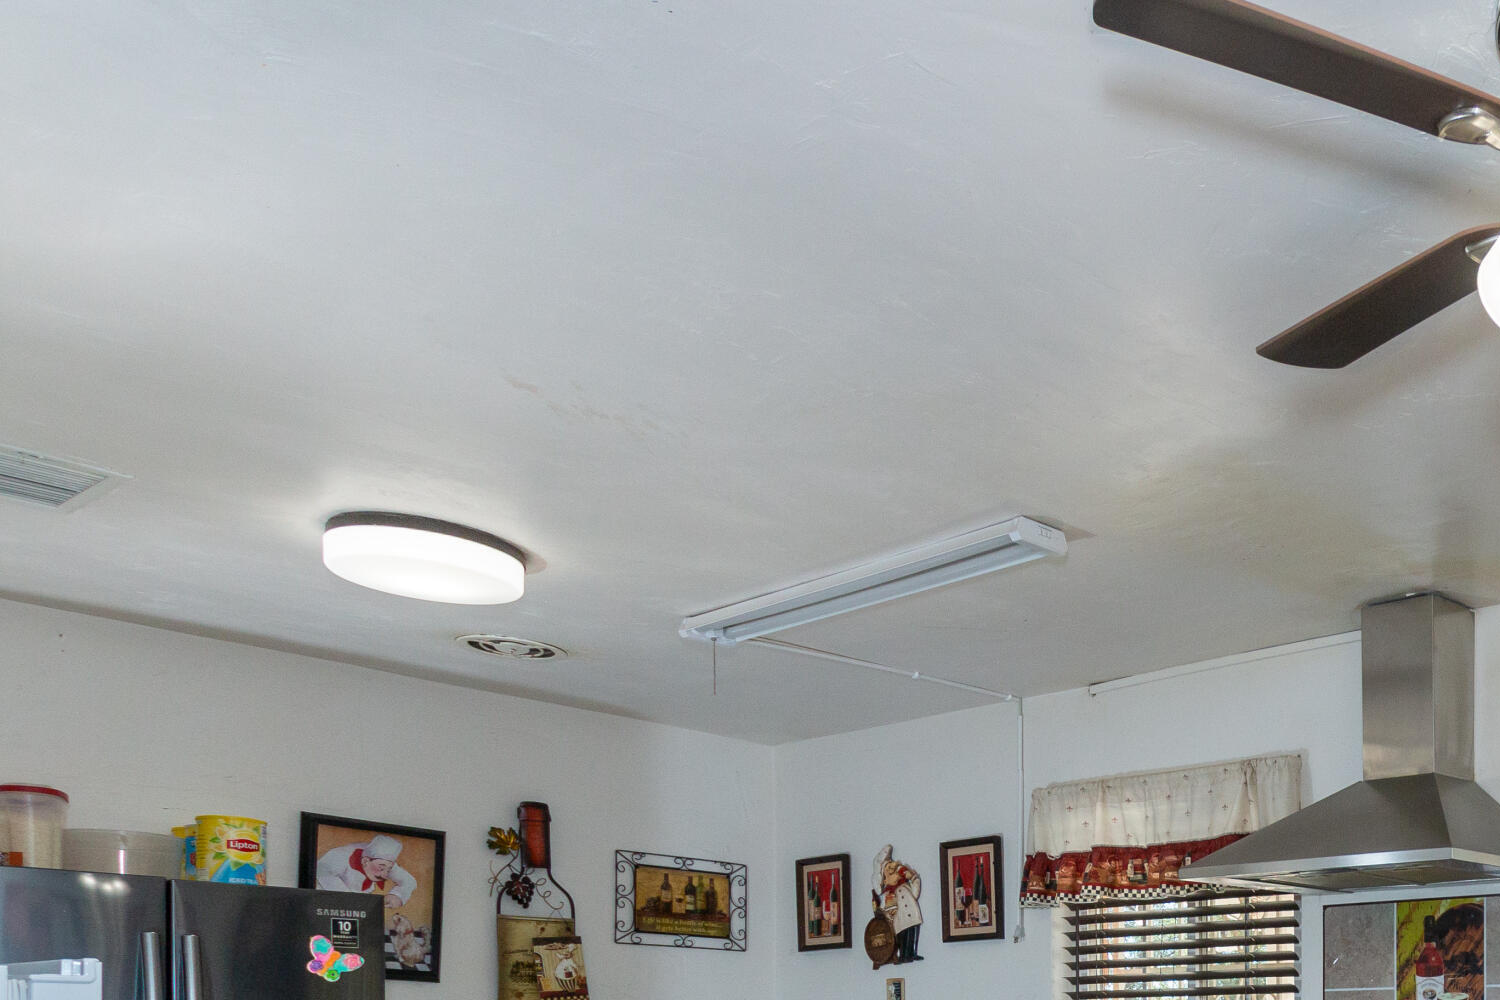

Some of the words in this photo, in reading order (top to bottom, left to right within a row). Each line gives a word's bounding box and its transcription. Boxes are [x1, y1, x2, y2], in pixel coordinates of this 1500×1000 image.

[230, 841, 259, 850] Lipton
[316, 908, 367, 919] SAMSUNG
[338, 921, 352, 932] 10
